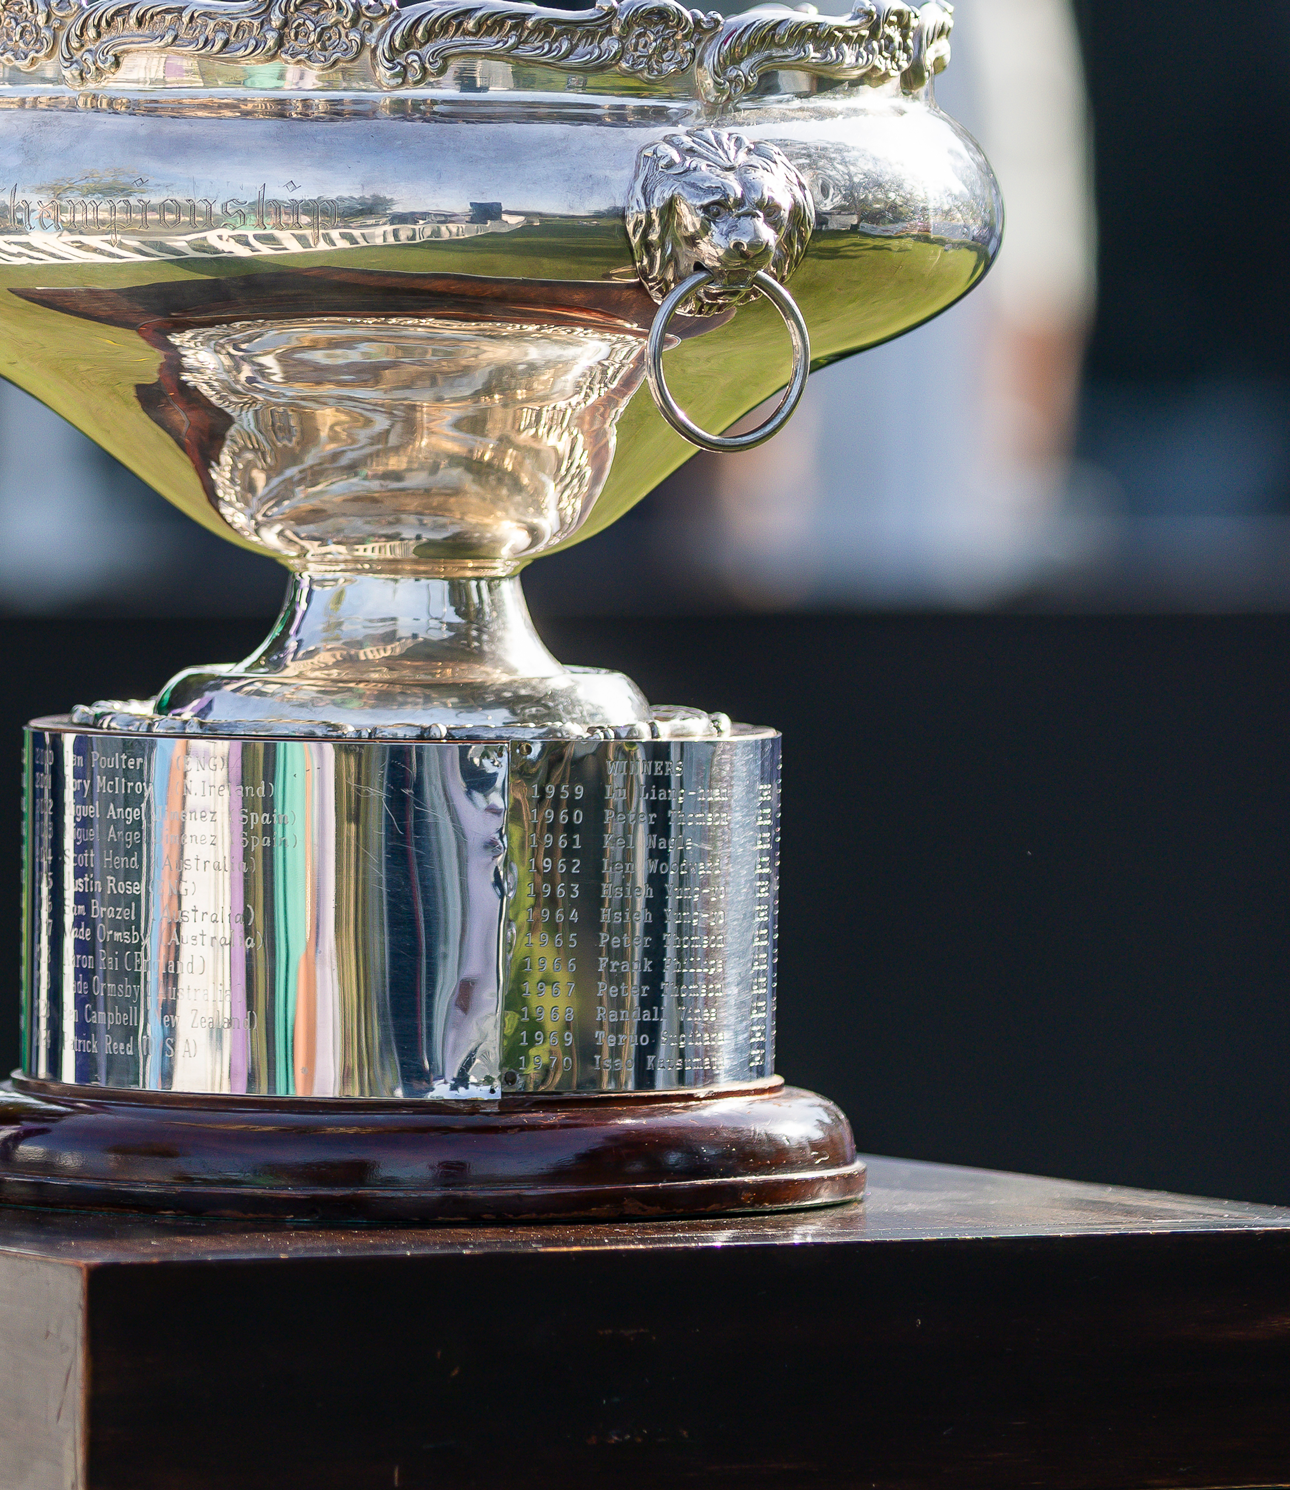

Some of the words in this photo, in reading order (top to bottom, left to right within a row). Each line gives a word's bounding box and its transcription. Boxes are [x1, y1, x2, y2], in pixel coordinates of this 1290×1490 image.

[91, 751, 144, 769] Poulter
[605, 760, 685, 776] WINNERS
[531, 784, 585, 800] 1959
[604, 785, 628, 800] Lu
[530, 808, 584, 825] 1960
[603, 809, 658, 825] Peter
[529, 833, 582, 849] 1961
[602, 834, 636, 849] Kel
[103, 849, 140, 870] Hend
[528, 857, 582, 874] 1962
[601, 858, 636, 874] Len
[106, 874, 142, 896] Rose
[527, 882, 580, 899] 1963
[600, 882, 655, 899] Hsieh
[90, 898, 136, 921] Brazel
[526, 907, 579, 924] 1964
[599, 907, 654, 924] Hsieh
[96, 923, 151, 946] Ormsby
[525, 932, 578, 948] 1965
[598, 932, 653, 949] Peter
[98, 949, 119, 971] Rai
[523, 956, 577, 972] 1966
[597, 957, 654, 973] Frank
[92, 974, 141, 1004] Ormsby
[521, 981, 576, 998] 1967
[596, 981, 651, 998] Peter
[84, 1002, 139, 1031] Campbell
[520, 1005, 575, 1022] 1968
[596, 1005, 668, 1022] Randall
[105, 1034, 134, 1056] Reed
[519, 1030, 574, 1046] 1969
[594, 1030, 650, 1047] Teruo
[518, 1055, 573, 1071] 1970
